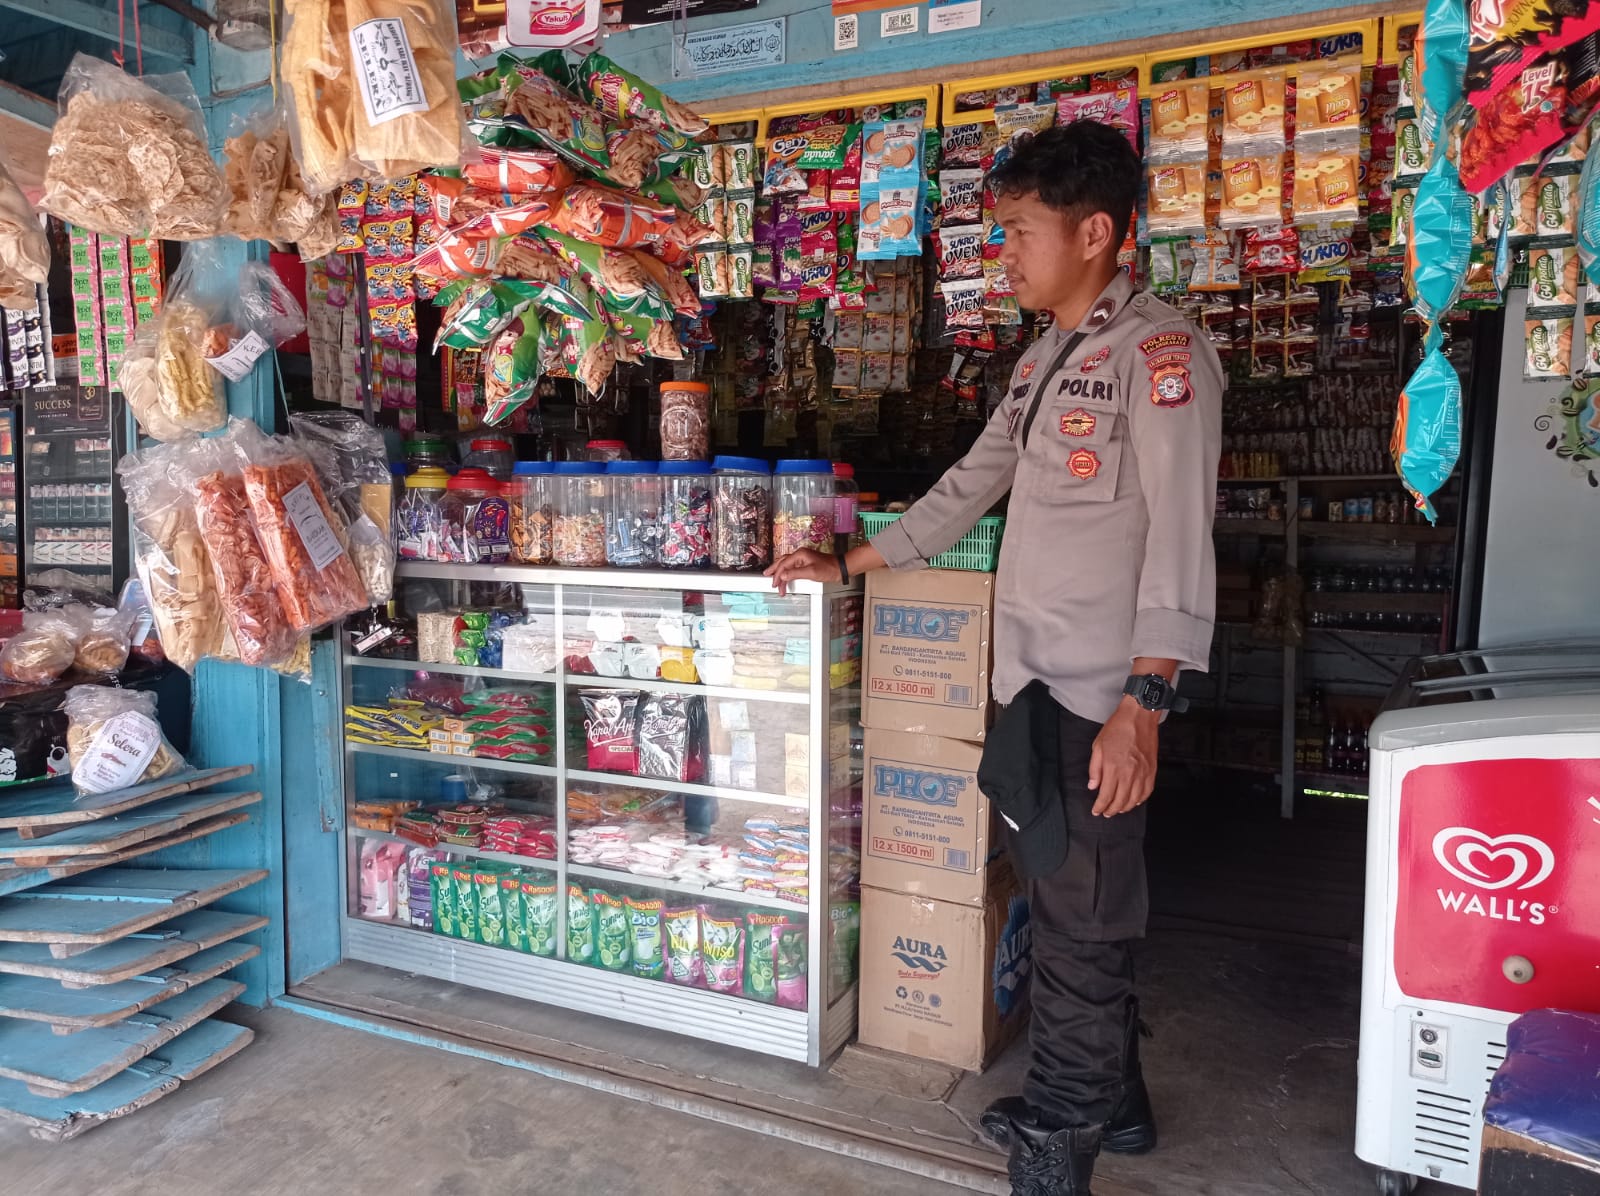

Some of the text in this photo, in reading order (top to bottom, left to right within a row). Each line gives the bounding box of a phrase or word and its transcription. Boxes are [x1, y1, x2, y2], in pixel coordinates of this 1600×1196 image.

[543, 14, 569, 23] Yakult
[900, 13, 911, 25] M3
[358, 32, 381, 108] SELERA
[1523, 63, 1553, 84] Level
[1232, 92, 1257, 105] Gold
[1522, 80, 1549, 113] 15
[1158, 101, 1181, 114] Gold
[952, 124, 977, 137] SUKRO
[946, 132, 982, 152] OVEN
[803, 149, 836, 160] garuda
[1229, 170, 1254, 184] Gold
[949, 182, 975, 195] SUKRO
[944, 191, 978, 211] OVEN
[950, 236, 975, 249] SUKRO
[945, 246, 982, 264] OVEN
[1301, 241, 1349, 264] SUKRO
[951, 289, 976, 303] SUKRO
[946, 297, 983, 316] OVEN
[1142, 334, 1187, 350] POLRESTA
[1057, 378, 1113, 402] POLRI
[35, 399, 72, 410] SUCCESS
[873, 680, 934, 696] 12 x 1500 ml
[584, 718, 636, 742] Kapal Api
[107, 733, 142, 757] Selera
[874, 839, 885, 849] 12
[896, 844, 918, 856] 1500
[920, 848, 932, 858] ml
[1436, 888, 1546, 925] WALL'S
[632, 909, 658, 927] Bio
[892, 935, 948, 961] AURA
